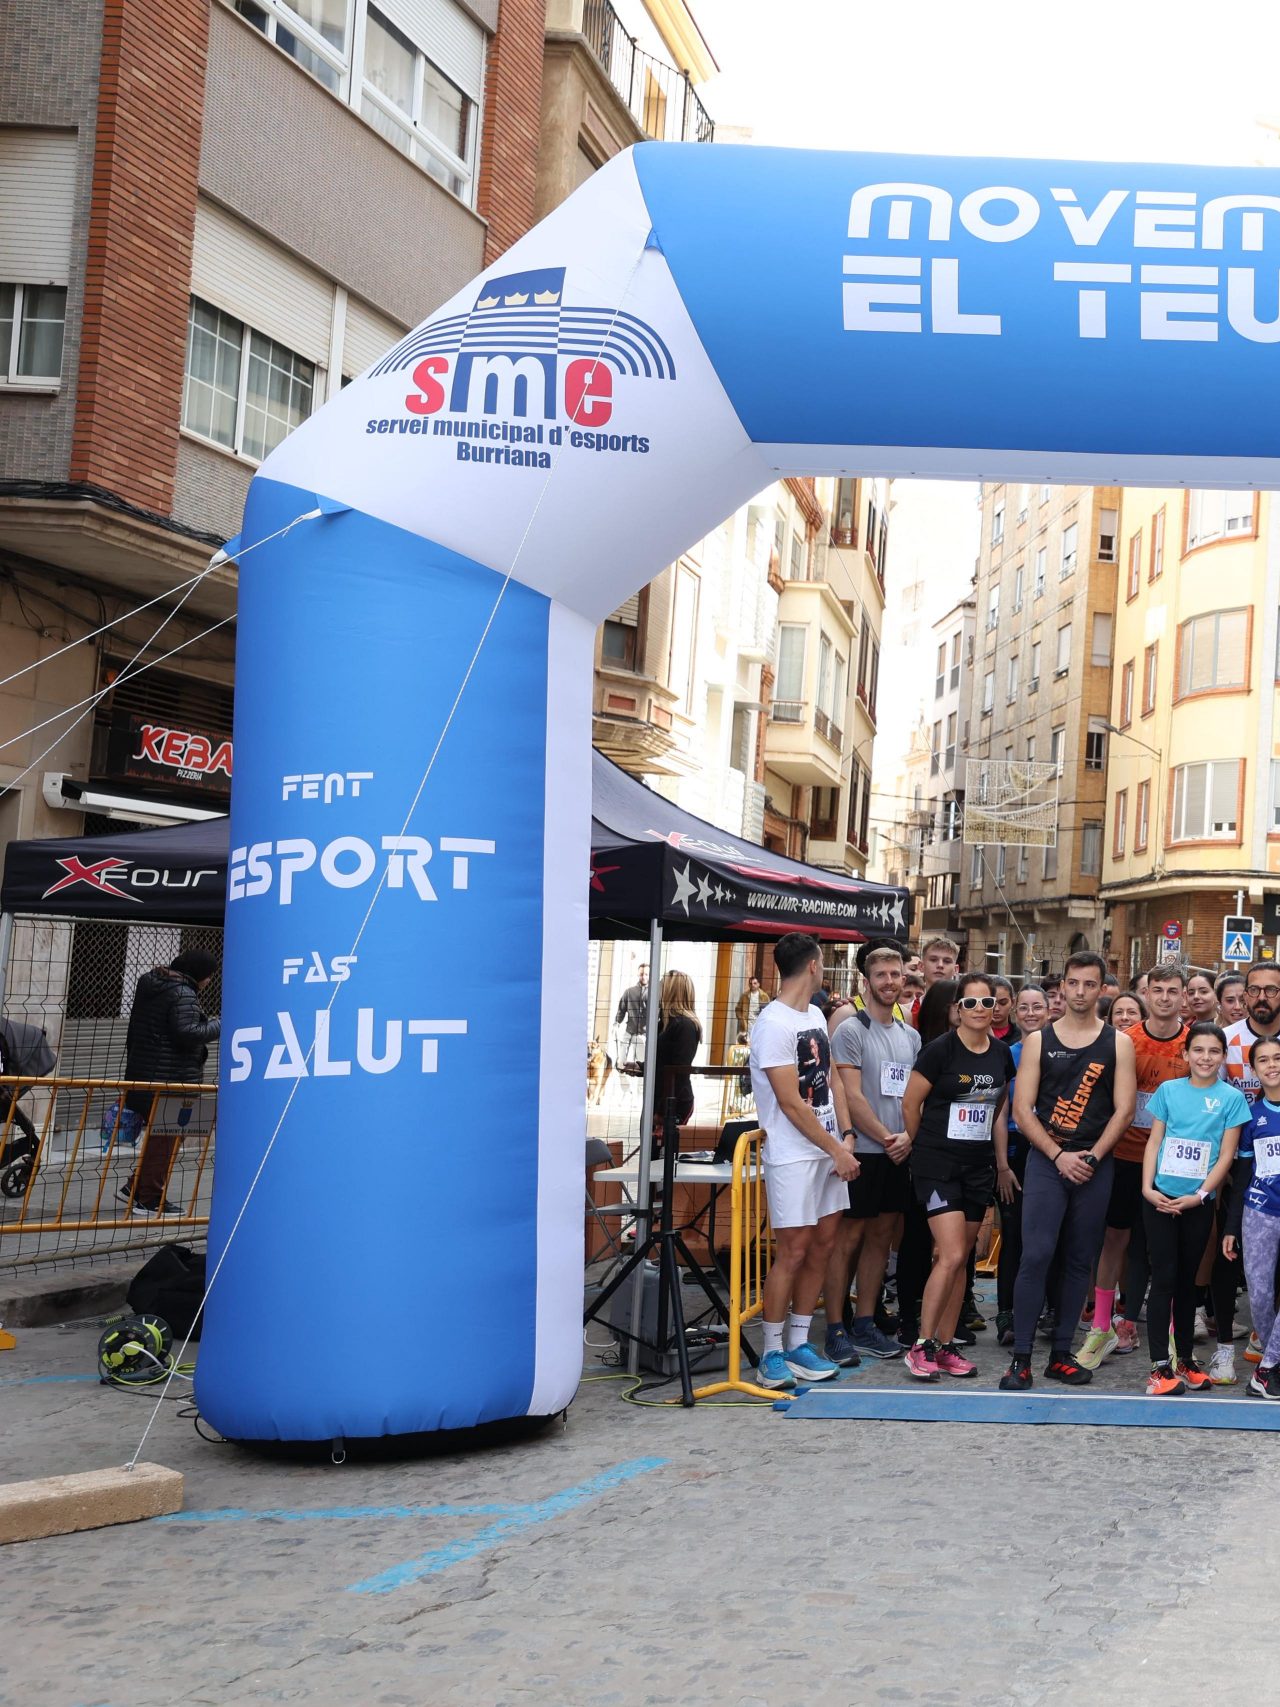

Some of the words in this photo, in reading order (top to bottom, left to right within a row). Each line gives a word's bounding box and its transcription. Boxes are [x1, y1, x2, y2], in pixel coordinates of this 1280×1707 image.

[842, 254, 1002, 336] EL
[405, 354, 613, 428] sme
[365, 416, 428, 435] servei
[433, 419, 544, 444] municipal
[549, 425, 650, 453] d'esports
[456, 441, 551, 469] Burriana
[176, 769, 203, 781] PIZZERIA
[282, 771, 374, 804] FENT
[229, 835, 496, 906] ESPORT
[747, 892, 857, 918] WWW.IMR-RACING.COM
[282, 951, 358, 985] FAS
[229, 1007, 468, 1083] SALUT
[890, 1067, 905, 1082] 336
[1060, 1062, 1105, 1129] VALENCIA
[1176, 1144, 1202, 1161] 395
